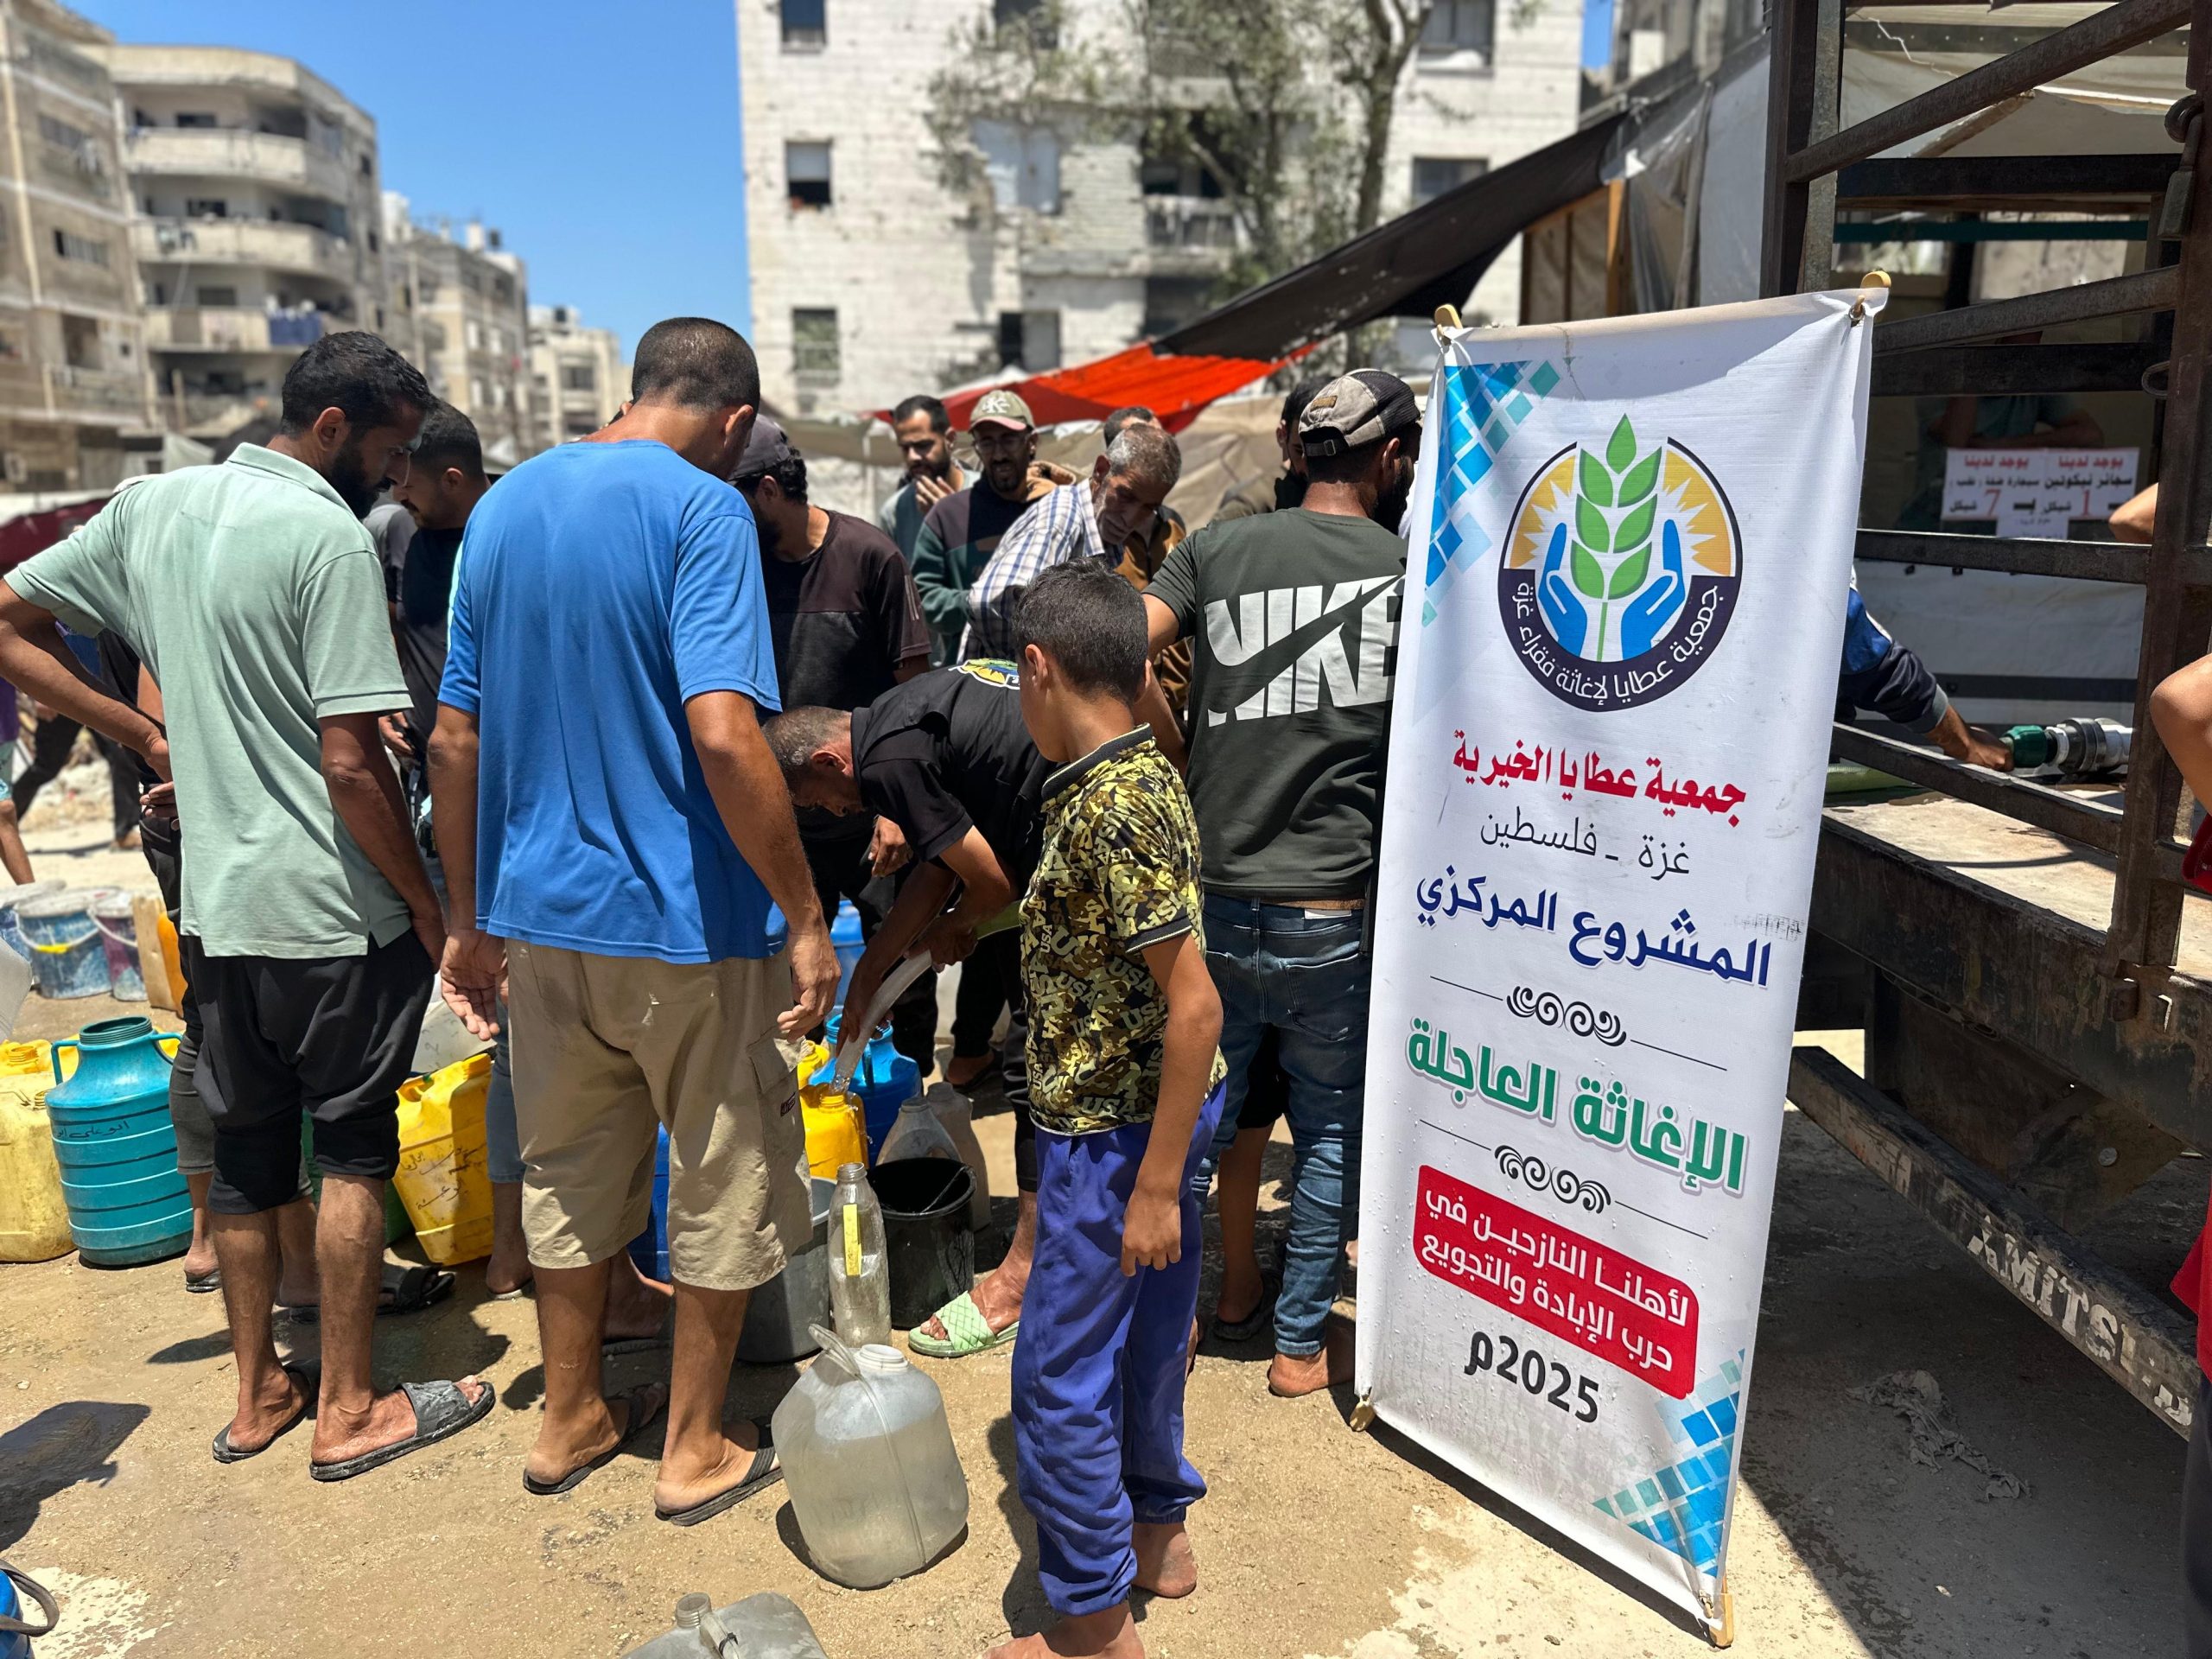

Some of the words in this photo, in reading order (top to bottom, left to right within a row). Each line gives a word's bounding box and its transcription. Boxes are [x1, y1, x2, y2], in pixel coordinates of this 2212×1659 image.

[1984, 488, 2001, 516] 7
[1511, 582, 1535, 620] غزة
[1669, 585, 1724, 663] جمعية
[1519, 626, 1556, 677] فقراء
[1555, 666, 1608, 705] لإغاثة
[1613, 660, 1674, 703] عطايا
[1452, 729, 1552, 788] الخيرية
[1559, 747, 1638, 802] عطايا
[1644, 756, 1746, 828] جمعية
[1480, 805, 1597, 856] فلسطين
[1638, 834, 1690, 880] غزة
[1416, 864, 1558, 930] المركزي
[1568, 908, 1771, 987] المشروع
[1108, 956, 1155, 998] USA
[1408, 1017, 1556, 1121] العاجلة
[1573, 1076, 1745, 1191] الإغاثة
[1425, 1189, 1468, 1225] في
[1421, 1233, 1526, 1306] والتجويع
[1473, 1211, 1587, 1280] النازحين
[1532, 1278, 1614, 1344] الإبادة
[1594, 1255, 1689, 1327] لأهلنا
[1621, 1327, 1673, 1372] حرب
